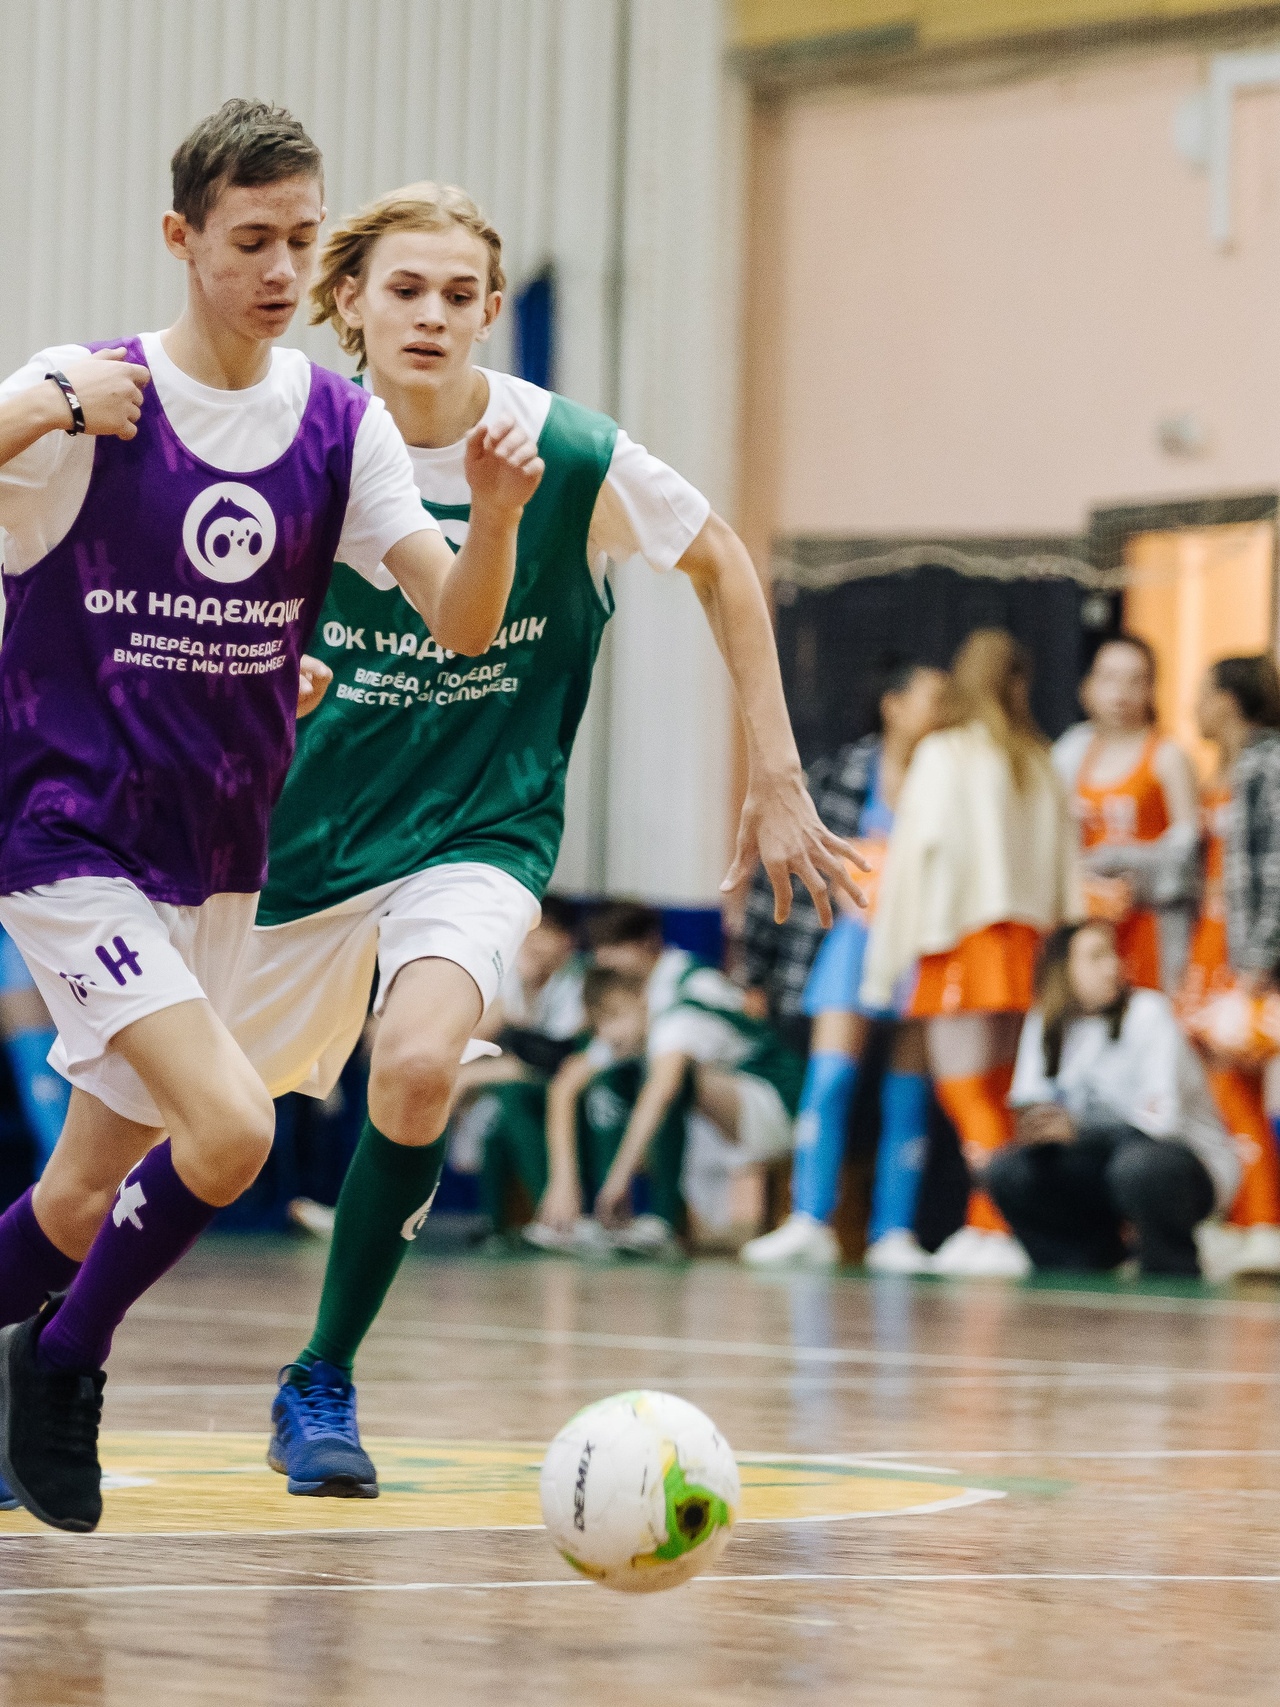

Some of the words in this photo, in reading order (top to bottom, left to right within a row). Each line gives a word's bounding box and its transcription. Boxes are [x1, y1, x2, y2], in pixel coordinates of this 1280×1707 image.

[84, 589, 138, 614] ФК
[148, 591, 305, 628] НАДЕЖДИК
[130, 632, 204, 656] ВПЕРЁД
[209, 643, 222, 656] К
[323, 621, 367, 650] ФК
[375, 616, 548, 664] НАДДИК
[113, 648, 187, 672] ВМЕСТЕ
[192, 660, 223, 674] МЫ
